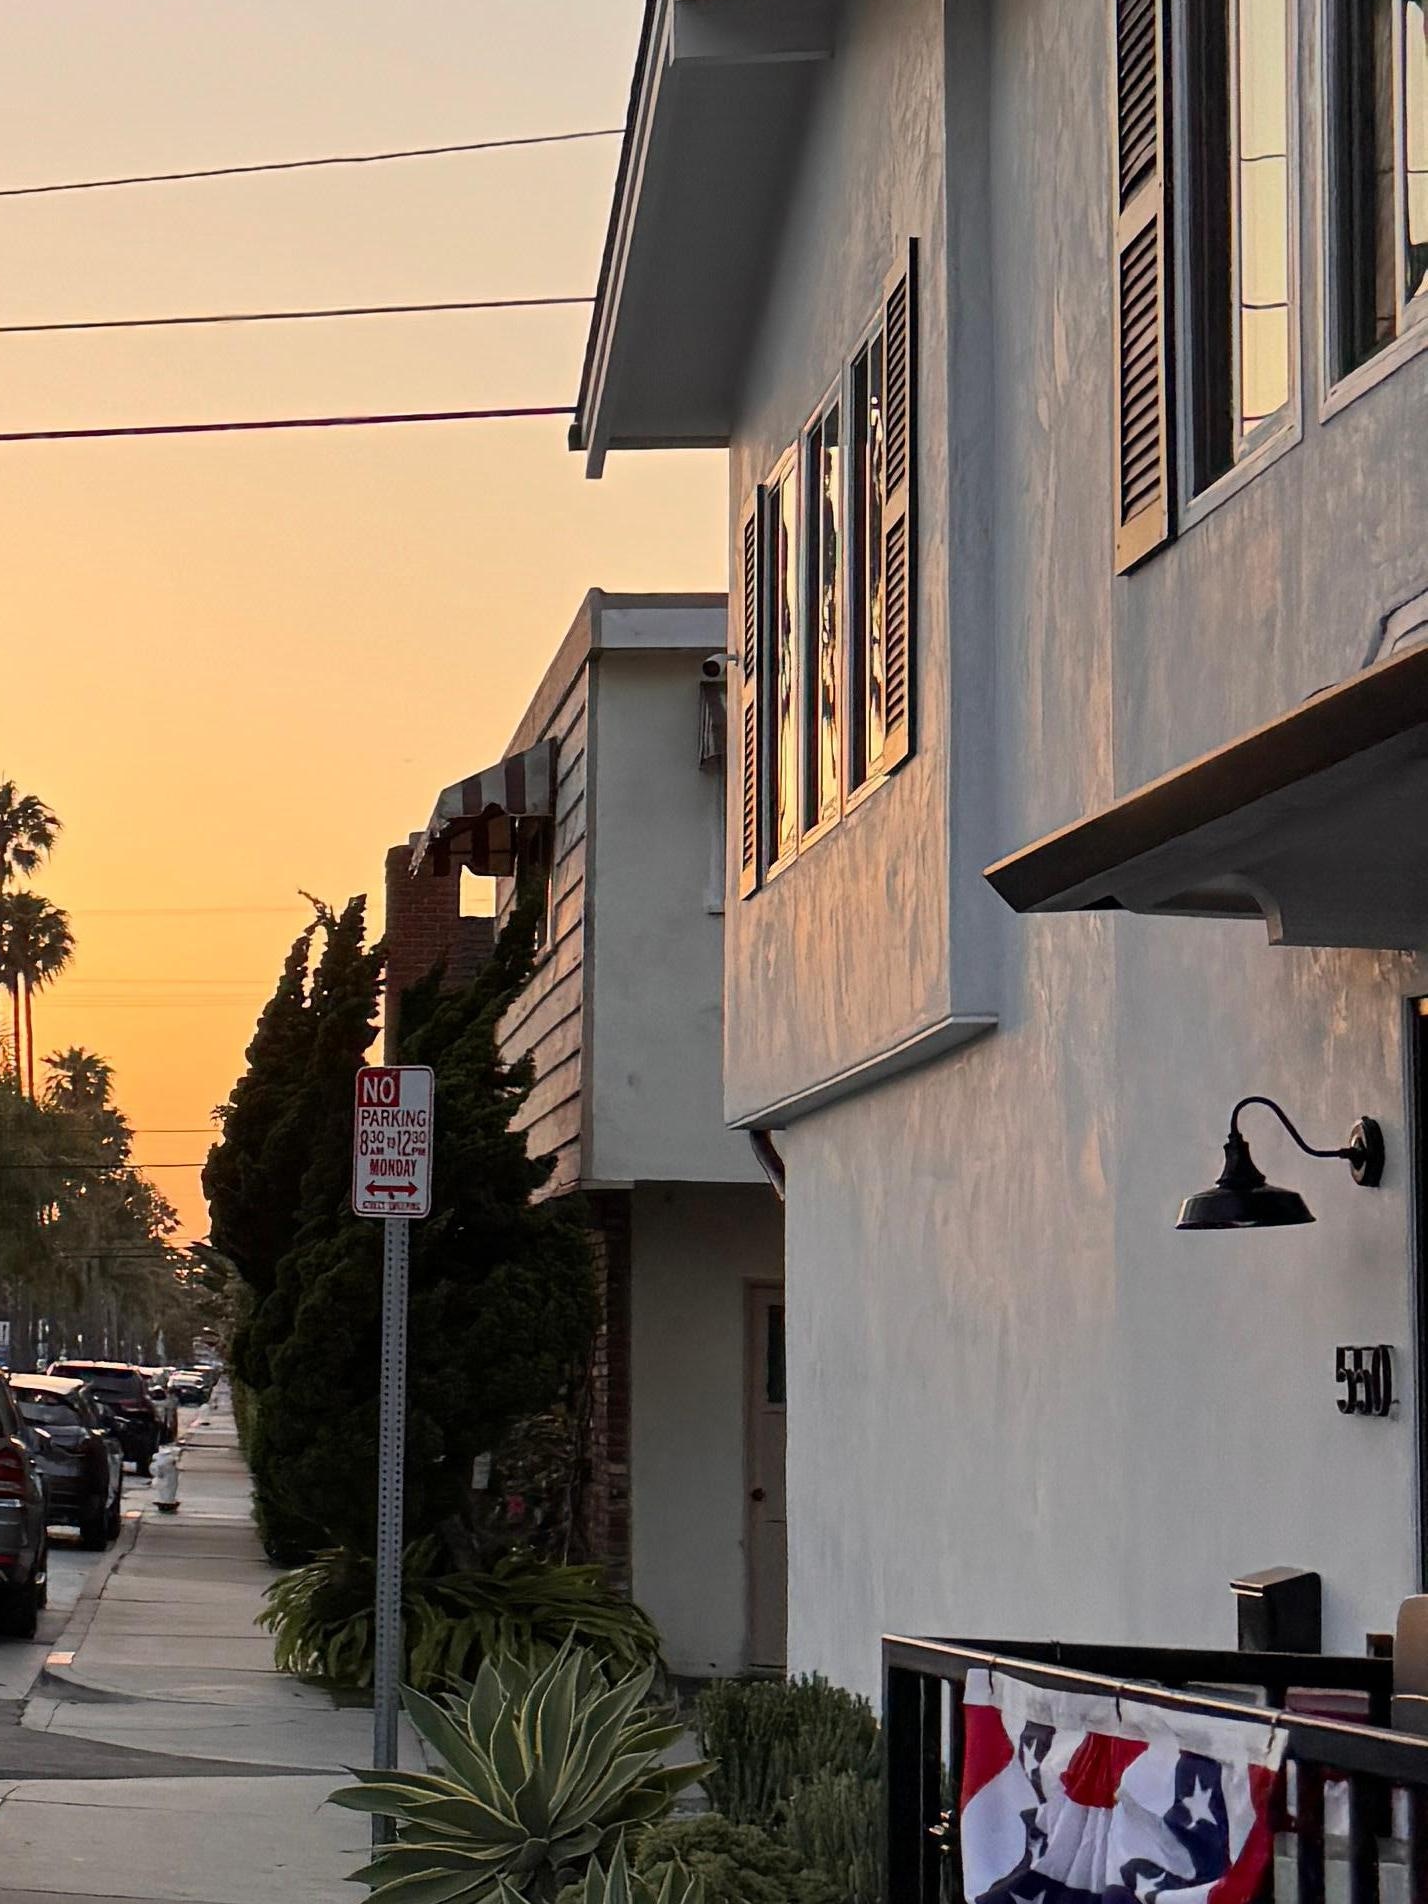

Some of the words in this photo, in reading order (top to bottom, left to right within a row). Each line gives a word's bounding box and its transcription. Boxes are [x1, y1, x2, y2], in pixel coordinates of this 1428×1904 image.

[363, 1077, 395, 1104] NO
[361, 1109, 426, 1128] PARKING
[369, 1159, 417, 1177] MONDAY
[1335, 1345, 1393, 1417] 550
